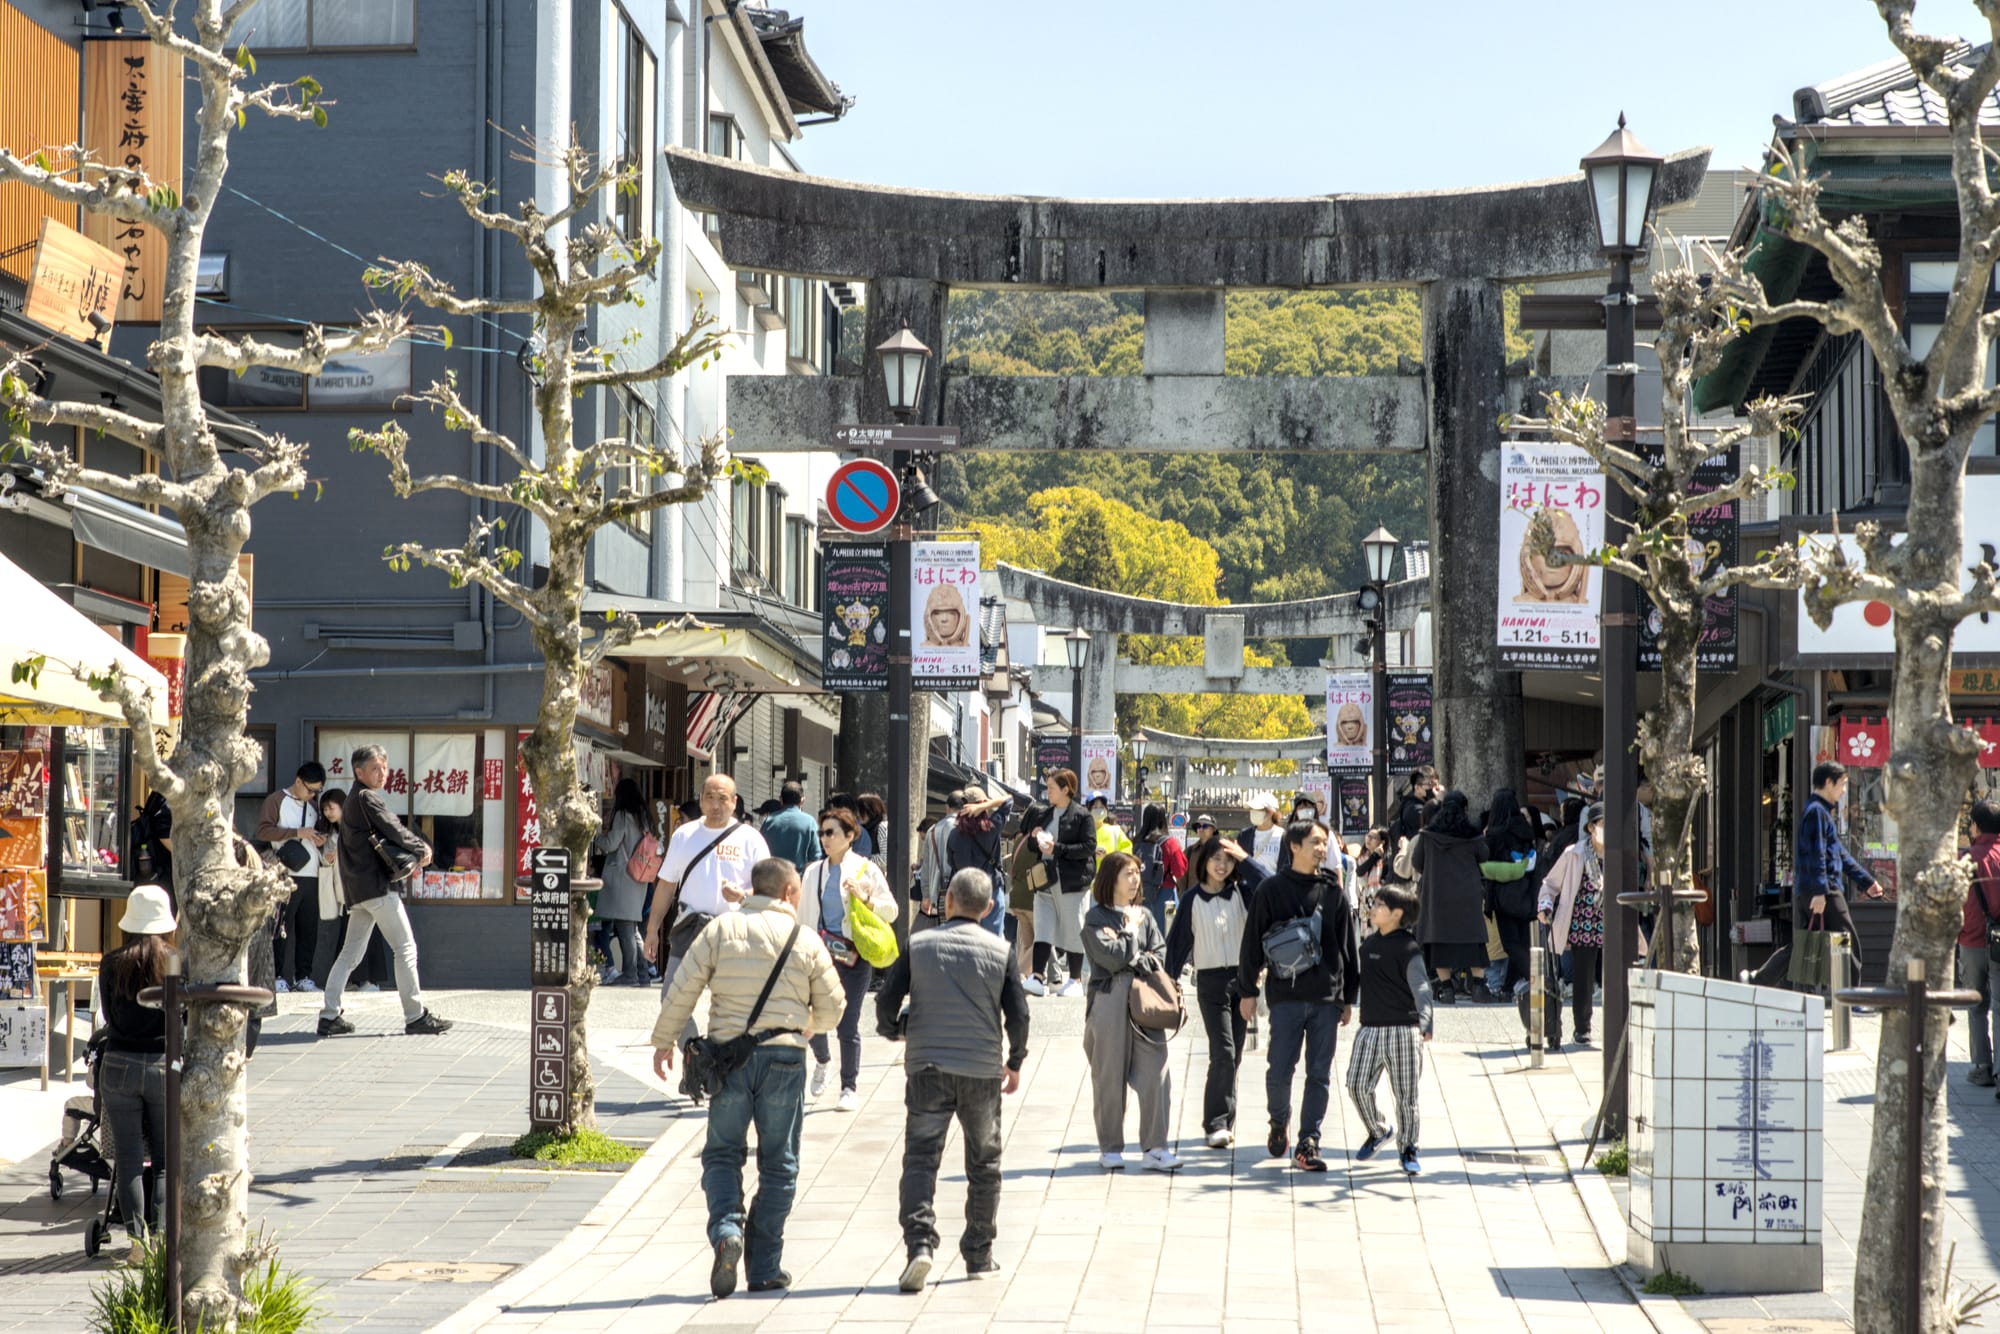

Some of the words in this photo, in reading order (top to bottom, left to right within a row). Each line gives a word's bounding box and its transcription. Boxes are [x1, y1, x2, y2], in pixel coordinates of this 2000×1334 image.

[858, 429, 892, 439] 太宰府館
[1511, 481, 1600, 508] はにわ
[918, 566, 976, 584] はにわ
[1962, 672, 2000, 692] 松尾
[1331, 691, 1372, 704] はにわ
[716, 844, 740, 858] USC
[533, 891, 569, 904] 太宰府館
